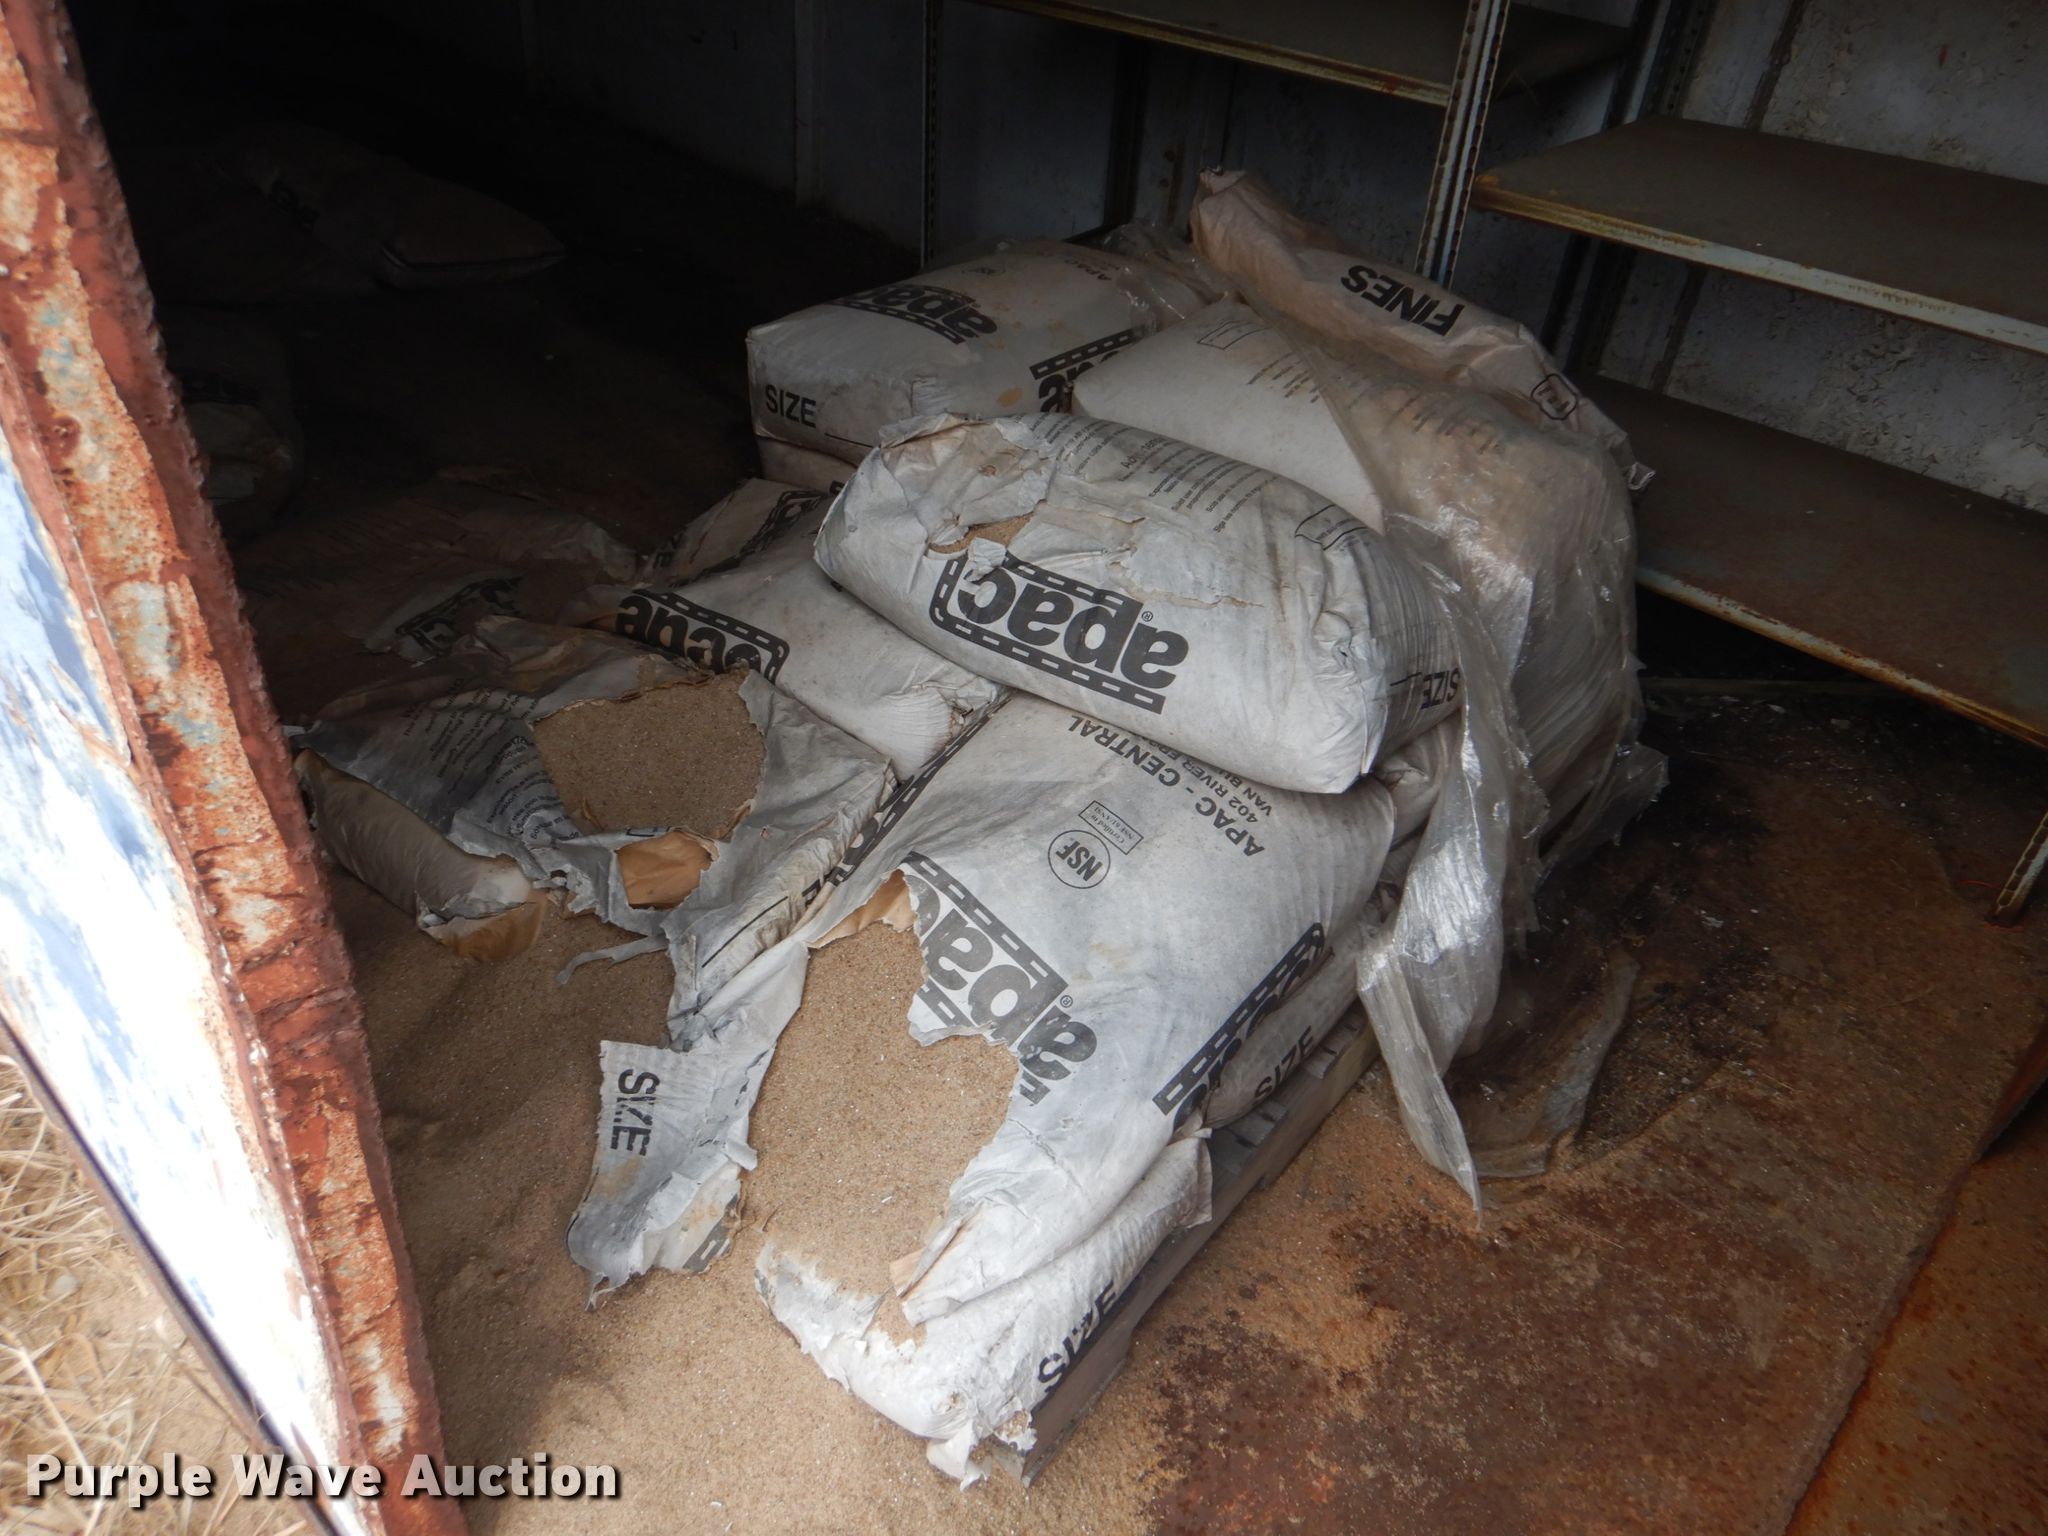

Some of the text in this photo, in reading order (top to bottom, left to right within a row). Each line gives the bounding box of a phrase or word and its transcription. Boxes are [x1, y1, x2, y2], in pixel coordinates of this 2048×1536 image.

[1340, 264, 1465, 336] FINES
[764, 384, 817, 428] SIZE
[957, 564, 1189, 690] apac
[1421, 668, 1461, 710] SIZE
[1068, 715, 1180, 787] CENTRAL
[1182, 759, 1228, 797] RIVER
[1228, 798, 1258, 824] 402
[1243, 787, 1273, 816] VAN
[1195, 796, 1265, 857] APAC
[1055, 837, 1103, 882] NSF
[611, 1066, 660, 1158] SIZE
